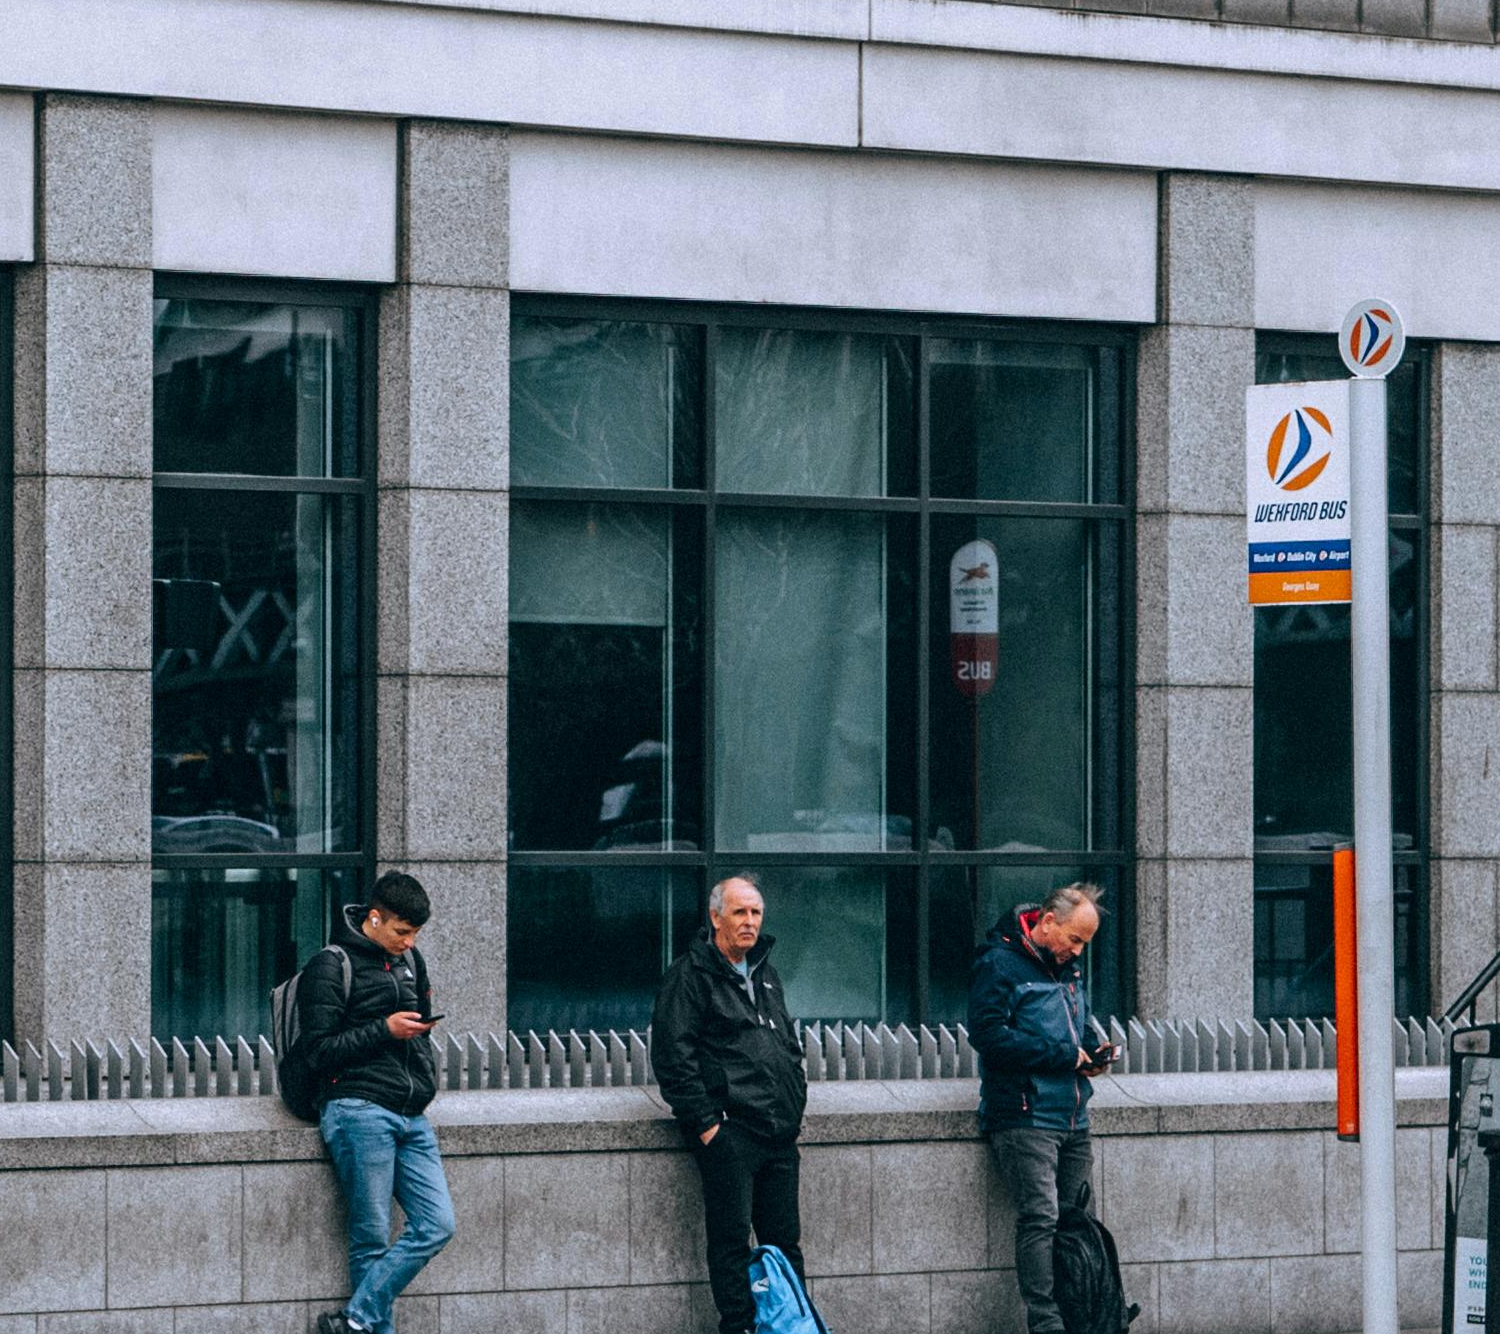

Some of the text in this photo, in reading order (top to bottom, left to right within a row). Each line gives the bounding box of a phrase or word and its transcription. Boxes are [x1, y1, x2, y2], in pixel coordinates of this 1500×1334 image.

[1254, 500, 1348, 523] WEXFORD BUS
[1286, 551, 1305, 562] Dublin
[1305, 551, 1317, 563] City
[1328, 550, 1350, 562] Airport
